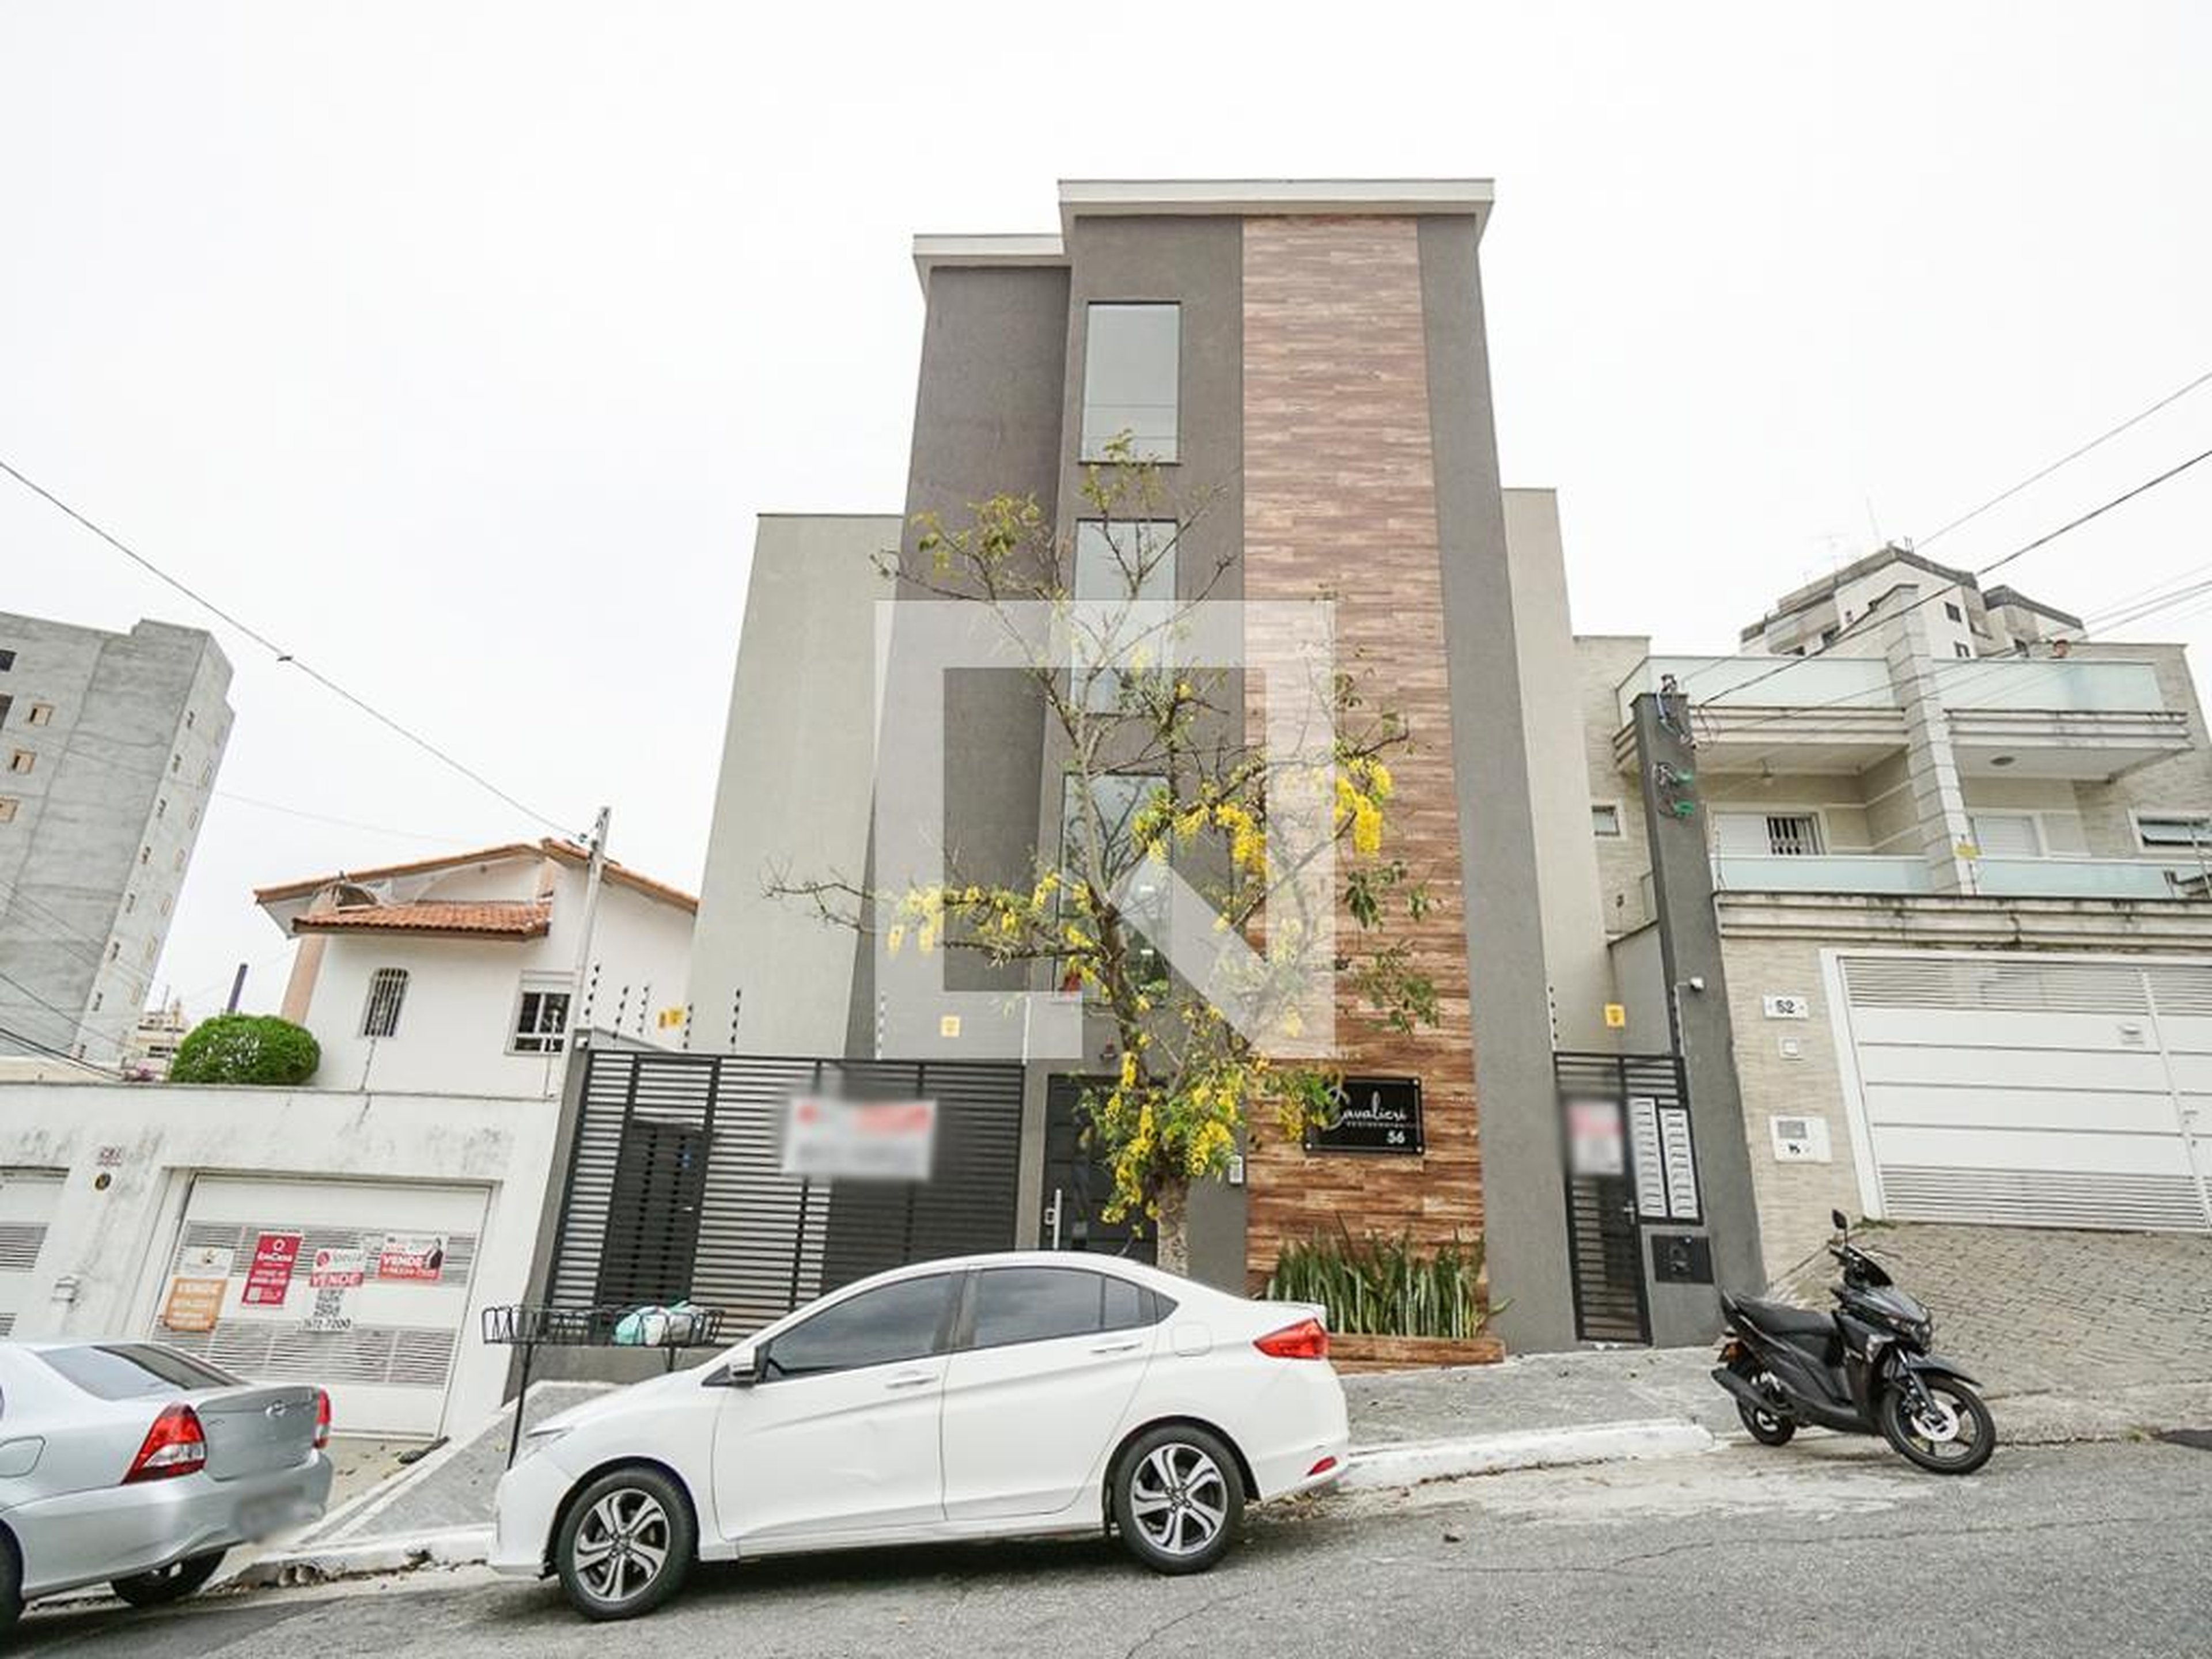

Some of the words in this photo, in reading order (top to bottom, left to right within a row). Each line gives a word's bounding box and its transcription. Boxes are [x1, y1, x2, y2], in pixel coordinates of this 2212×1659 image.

[1776, 999, 1795, 1014] 52
[1387, 1130, 1406, 1145] 56
[381, 1254, 424, 1268] VENDE
[312, 1272, 362, 1287] VENDE
